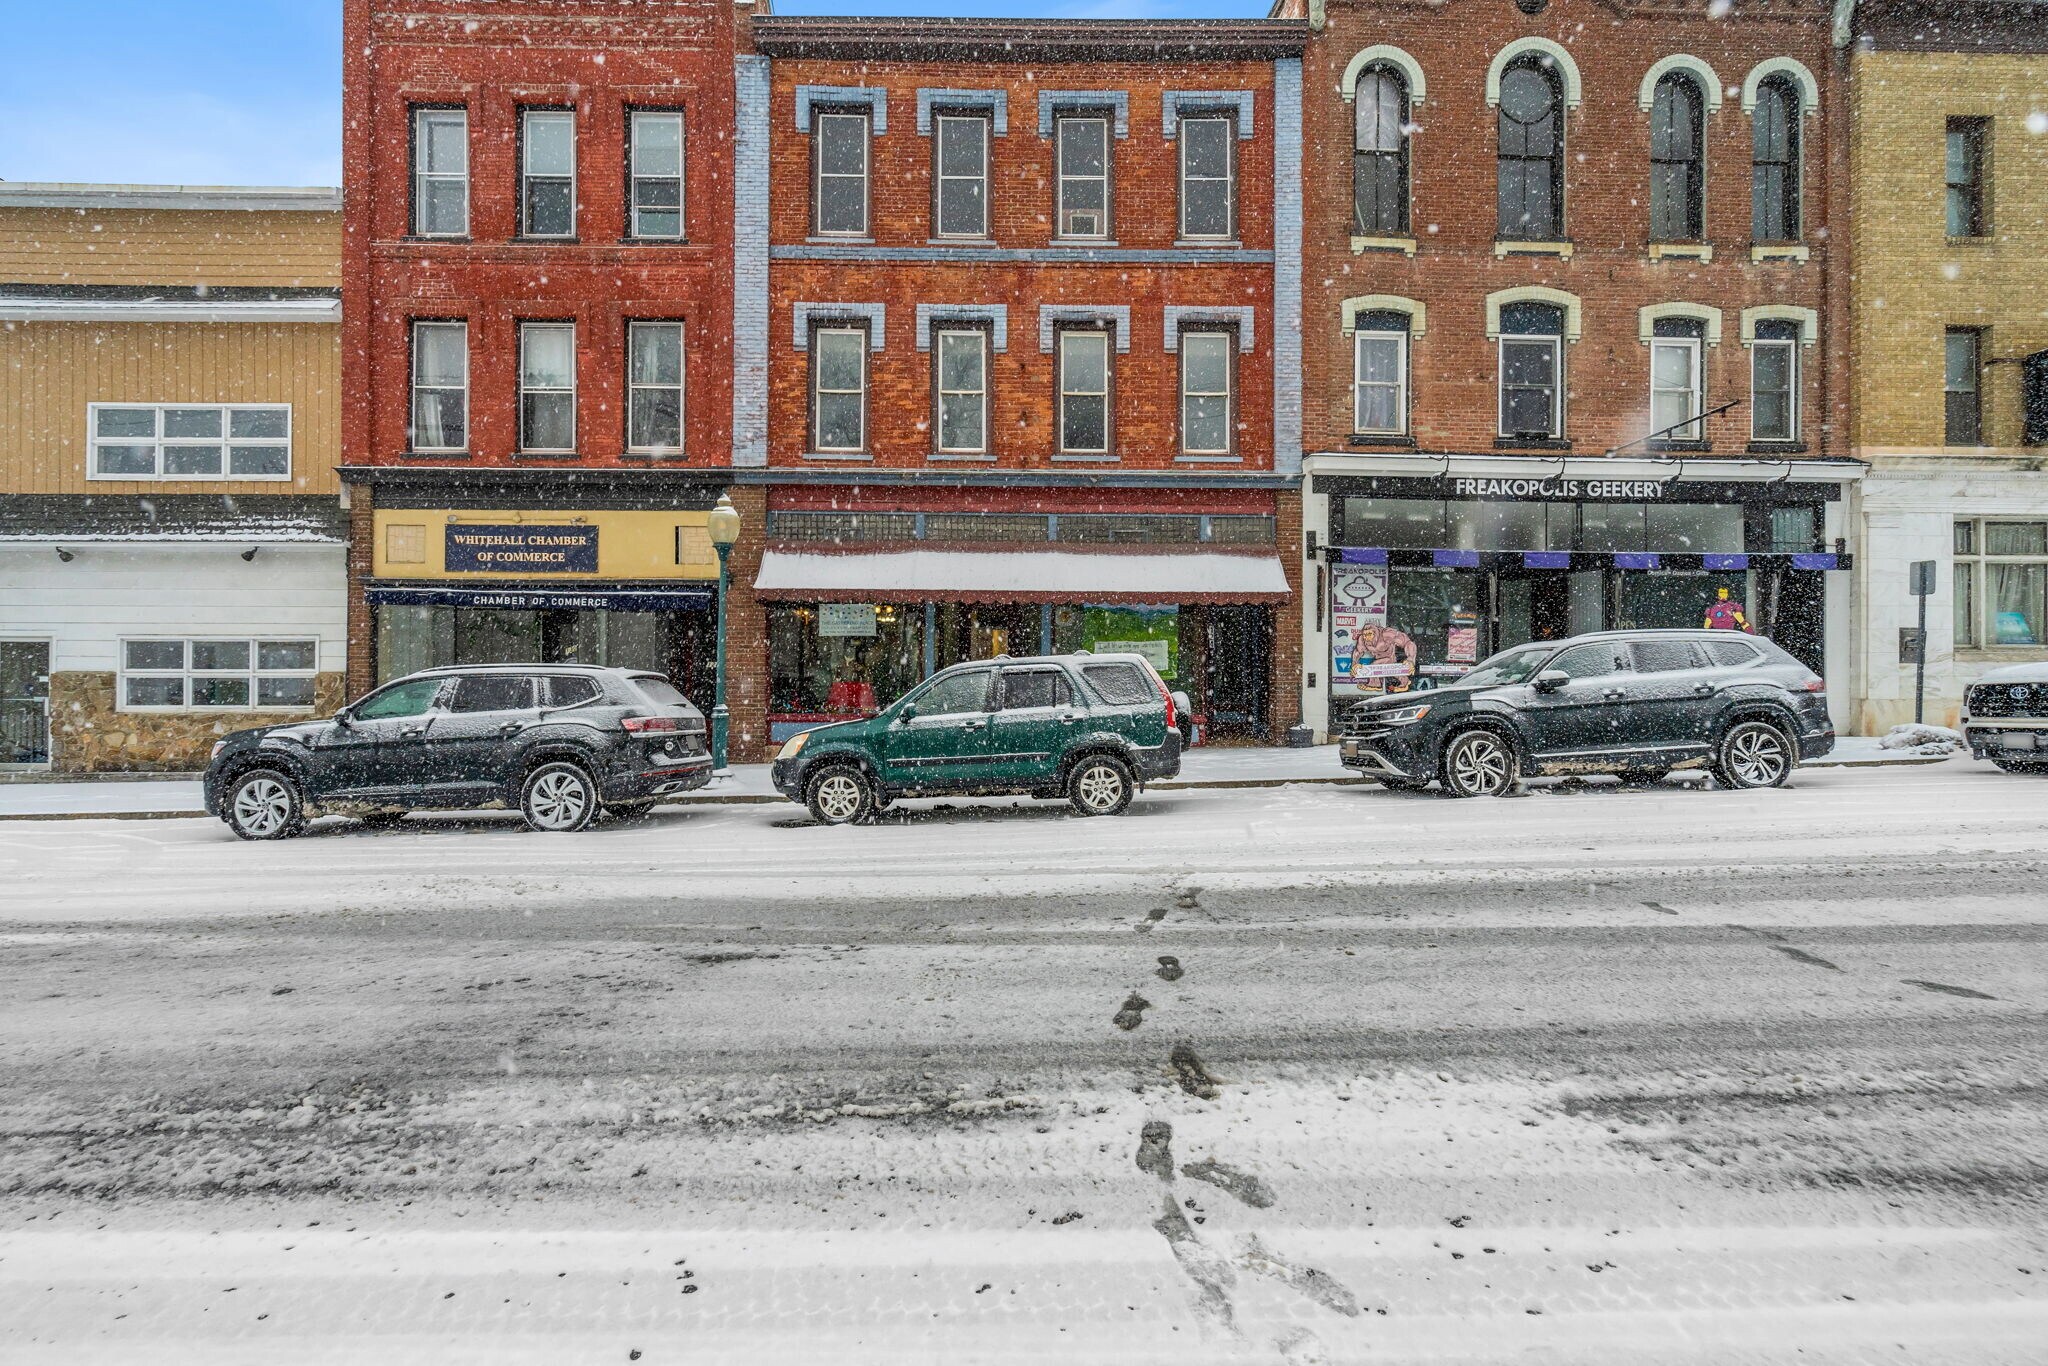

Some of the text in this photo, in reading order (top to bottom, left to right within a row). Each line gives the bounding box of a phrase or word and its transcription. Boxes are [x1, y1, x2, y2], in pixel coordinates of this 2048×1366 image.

[1586, 480, 1663, 498] GEEKERY
[454, 534, 587, 546] WHITEHALL CHAMBER
[477, 552, 566, 562] OF COMMERCE
[473, 596, 608, 607] CHAMBER OF COMMERCE
[1336, 617, 1356, 626] MARVEL
